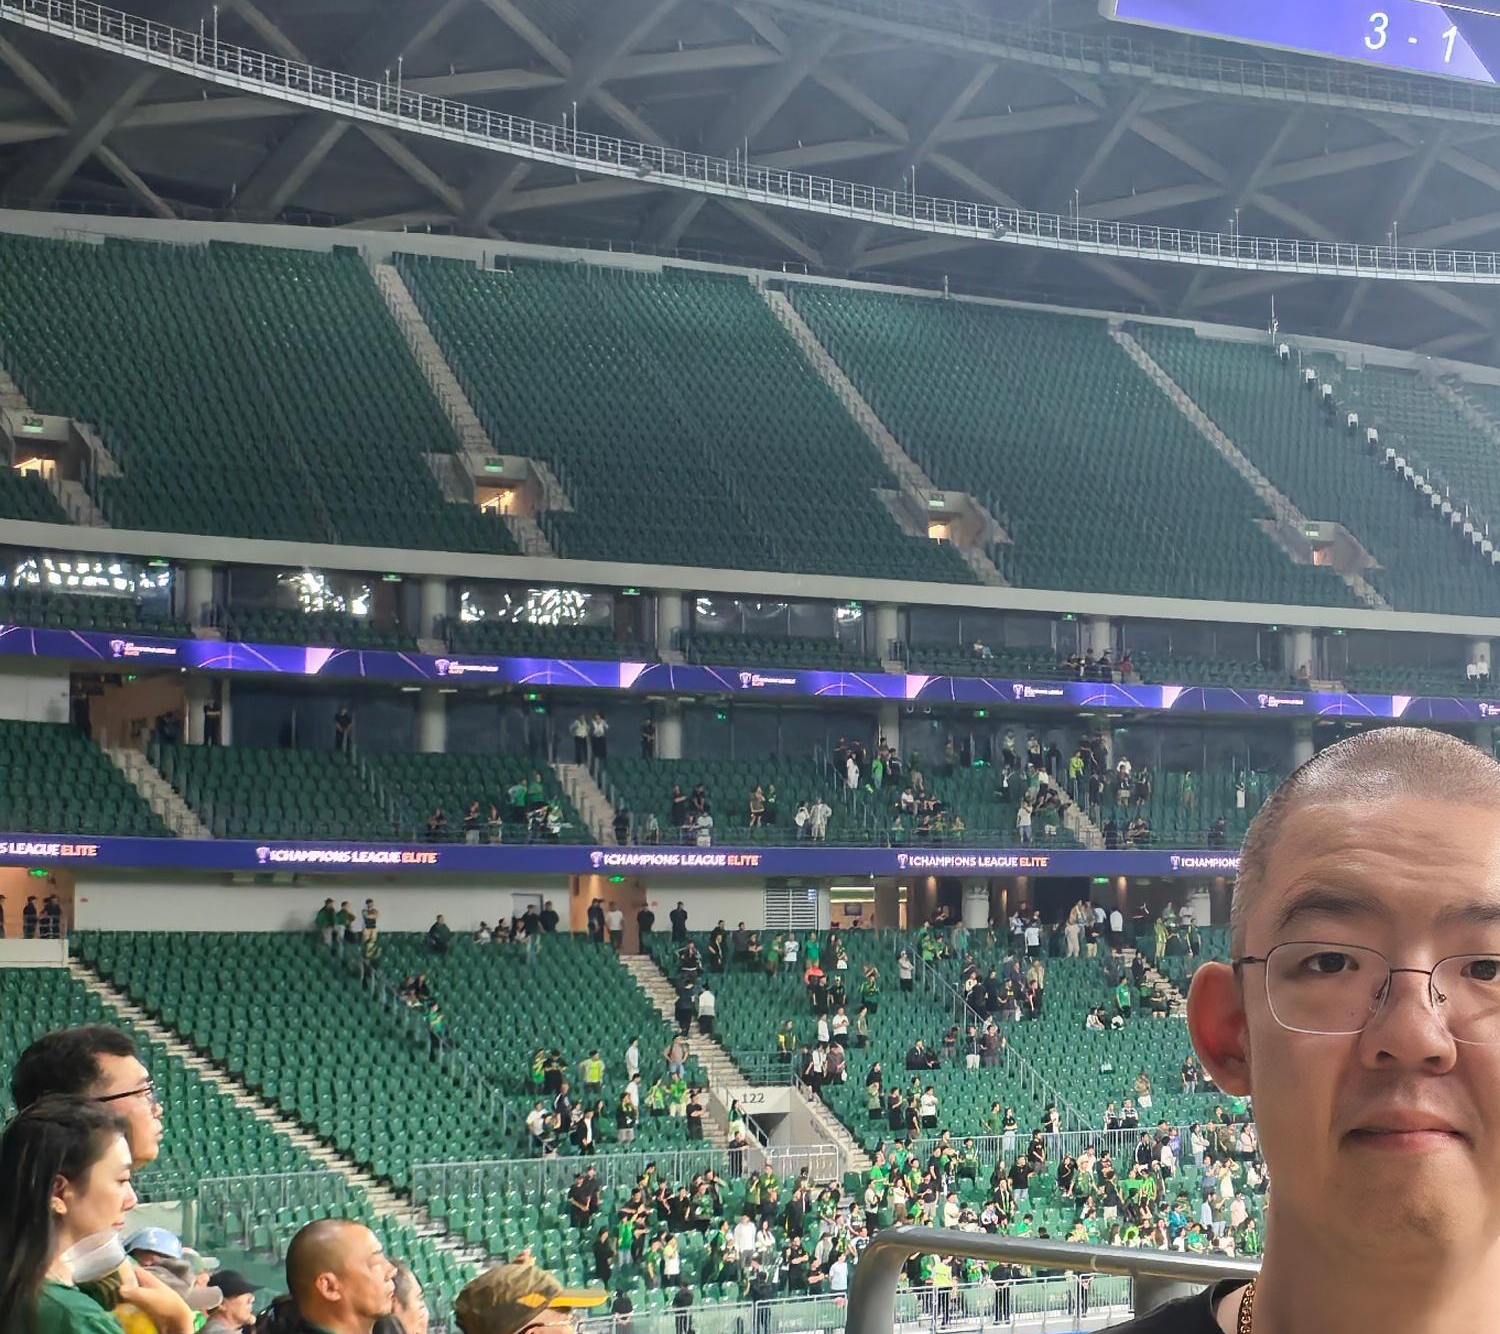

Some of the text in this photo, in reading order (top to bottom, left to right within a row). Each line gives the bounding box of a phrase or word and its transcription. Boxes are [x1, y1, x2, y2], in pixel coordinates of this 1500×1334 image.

[1364, 11, 1389, 50] 3
[1441, 24, 1458, 63] 1
[9, 841, 60, 856] LEAGUE
[60, 844, 98, 856] ELITE
[276, 850, 437, 864] CHAMPIONS LEAGUE ELITE
[609, 853, 759, 866] CHAMPIONS LEAGUE ELITE
[914, 856, 1048, 867] CHAMPIONS LEAGUE ELITE
[742, 1092, 765, 1104] 122
